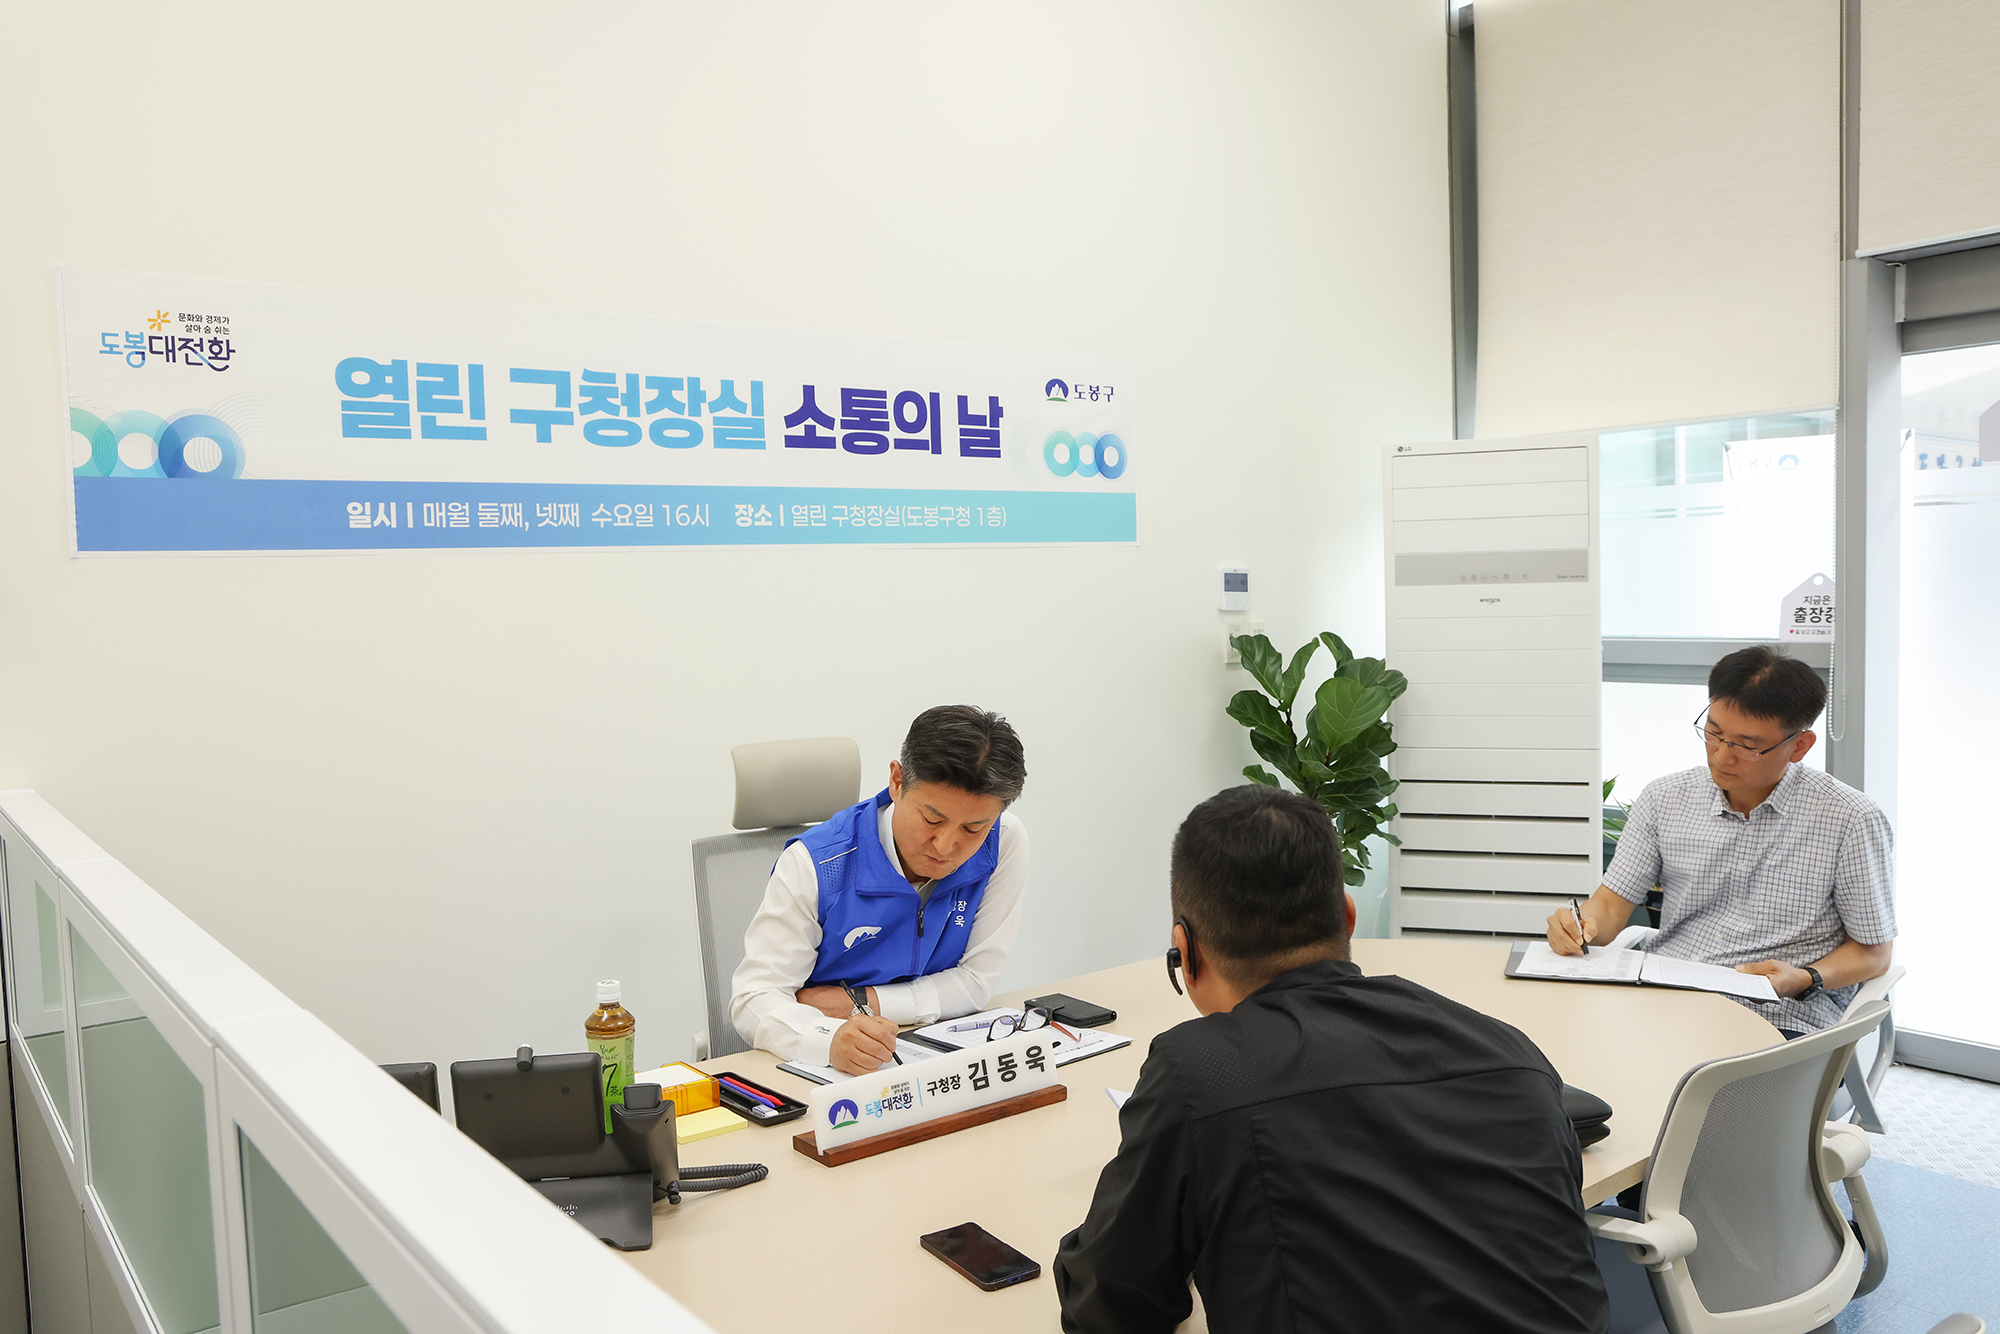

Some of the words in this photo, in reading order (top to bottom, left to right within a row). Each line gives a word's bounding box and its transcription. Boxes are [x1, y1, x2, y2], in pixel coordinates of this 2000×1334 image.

[178, 313, 203, 323] 문화와
[205, 314, 230, 325] 경제가
[184, 324, 201, 333] 살아
[203, 325, 212, 335] 숨
[214, 326, 230, 336] 쉬는
[99, 331, 236, 372] 도봉대전환
[1073, 383, 1116, 403] 도봉구
[334, 356, 487, 441] 열린
[509, 367, 767, 450] 구청장실
[783, 384, 943, 456] 소통의
[956, 394, 1004, 459] 날
[346, 502, 397, 529] 일시
[423, 502, 470, 528] 매월
[477, 502, 530, 531] 둘째,
[536, 503, 580, 528] 넷째
[591, 503, 654, 528] 수요일
[661, 504, 710, 528] 16시
[734, 504, 773, 527] 장소
[791, 504, 827, 528] 열린
[976, 505, 1007, 527] 1층)
[1803, 595, 1831, 606] 지금은
[865, 1092, 914, 1118] 도봉대전환
[926, 1074, 961, 1097] 구청장
